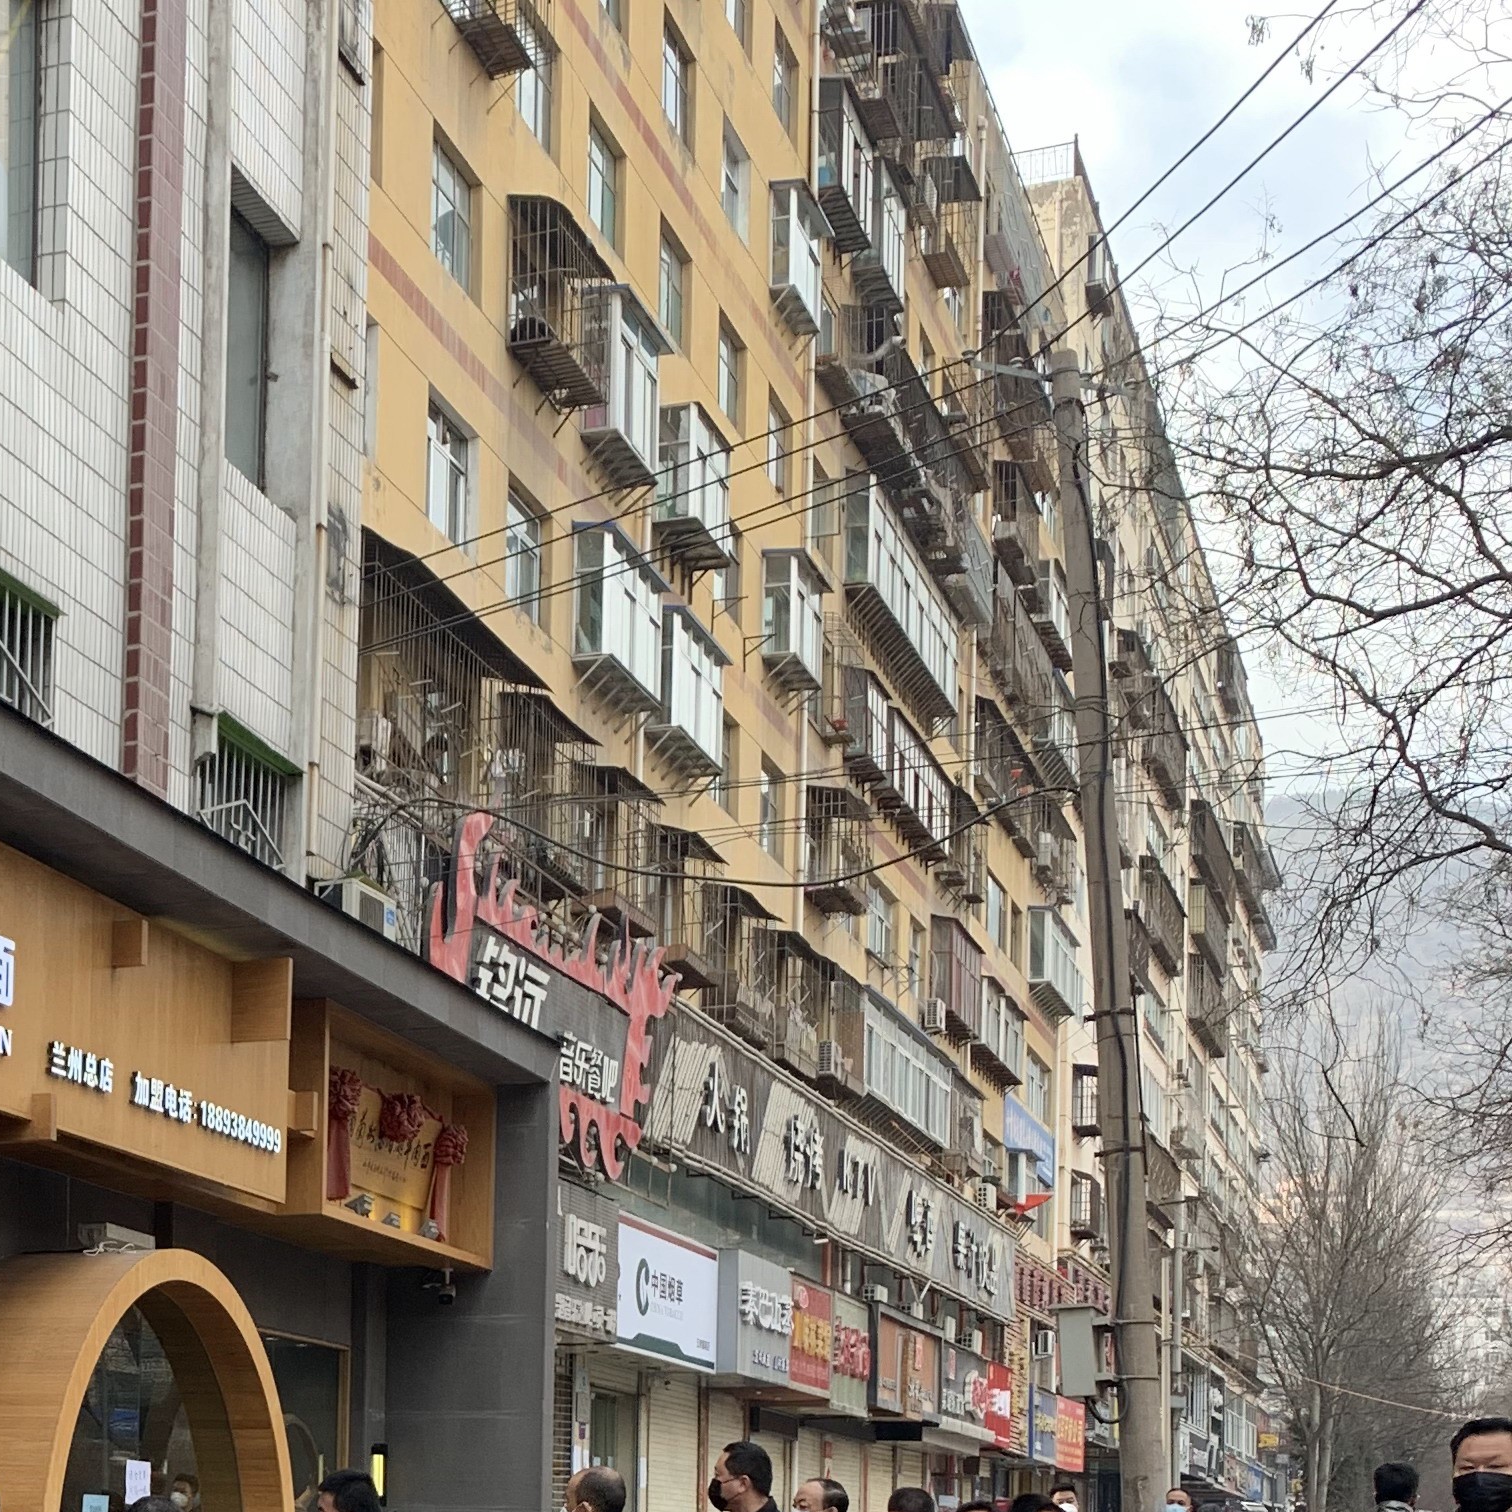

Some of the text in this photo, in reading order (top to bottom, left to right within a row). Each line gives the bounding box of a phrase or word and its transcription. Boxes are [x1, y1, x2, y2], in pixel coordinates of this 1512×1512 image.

[51, 1041, 114, 1093] 兰州总店
[841, 1151, 876, 1207] KTV
[651, 1269, 683, 1306] 中国烟草
